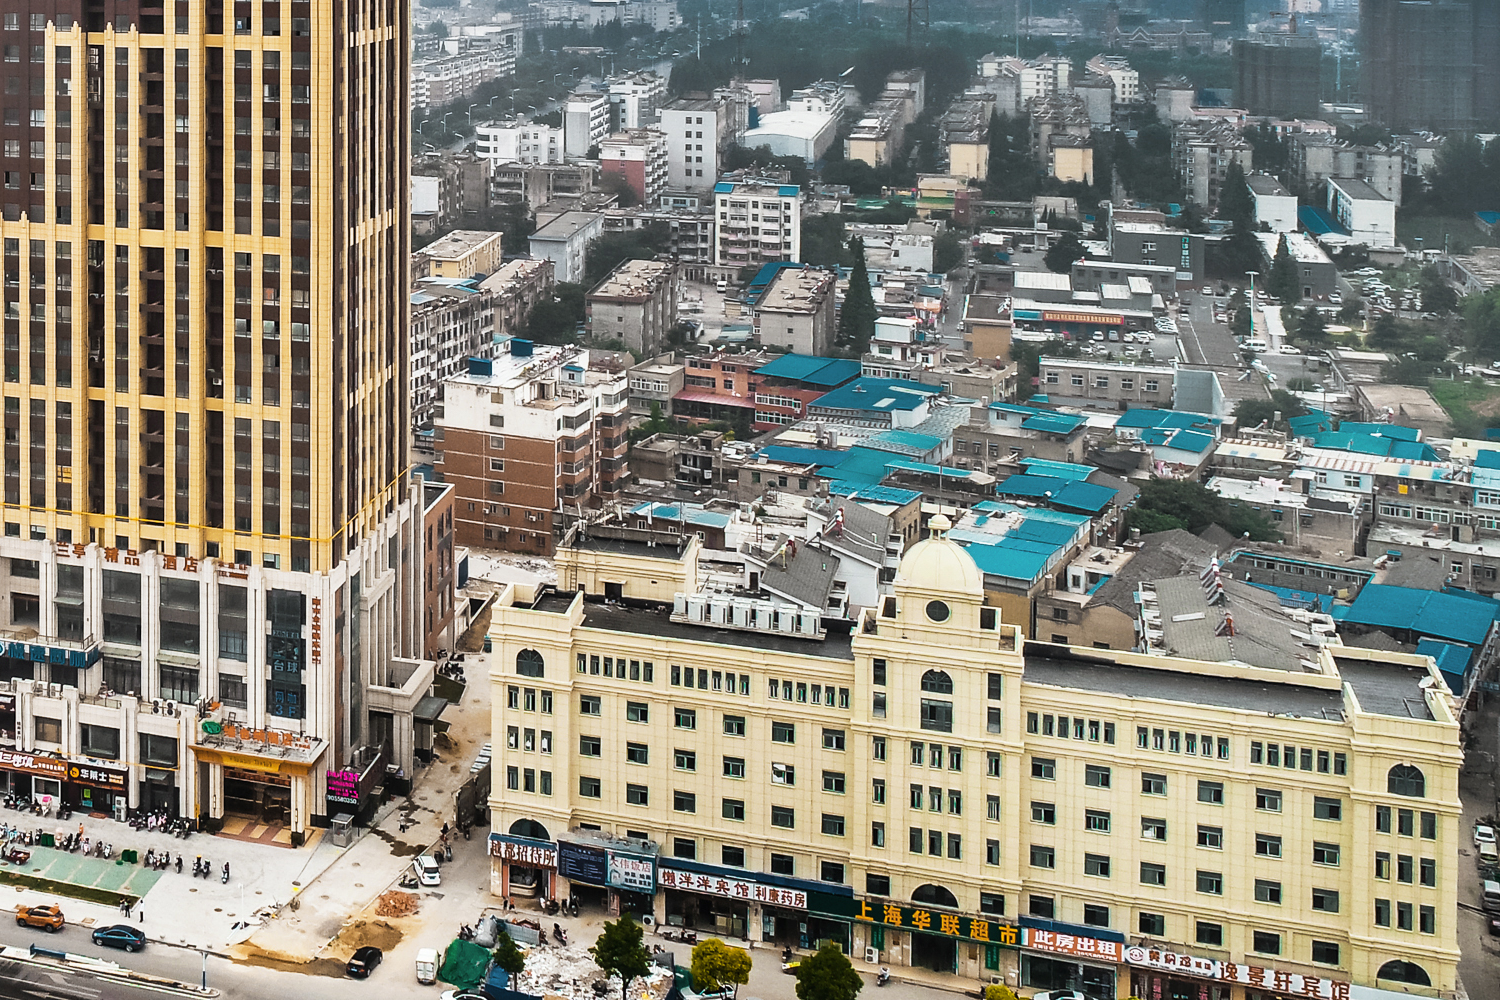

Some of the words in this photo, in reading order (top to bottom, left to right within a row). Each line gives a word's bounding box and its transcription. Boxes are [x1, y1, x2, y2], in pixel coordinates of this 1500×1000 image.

[273, 660, 298, 673] 台球
[80, 768, 107, 782] 华莱士
[662, 869, 749, 898] 懒洋洋宾馆
[755, 884, 805, 908] 利康药房
[854, 901, 1018, 945] 上海华联超市
[1033, 928, 1117, 956] 此房出租
[1219, 961, 1350, 1000] 逸景轩宾馆
